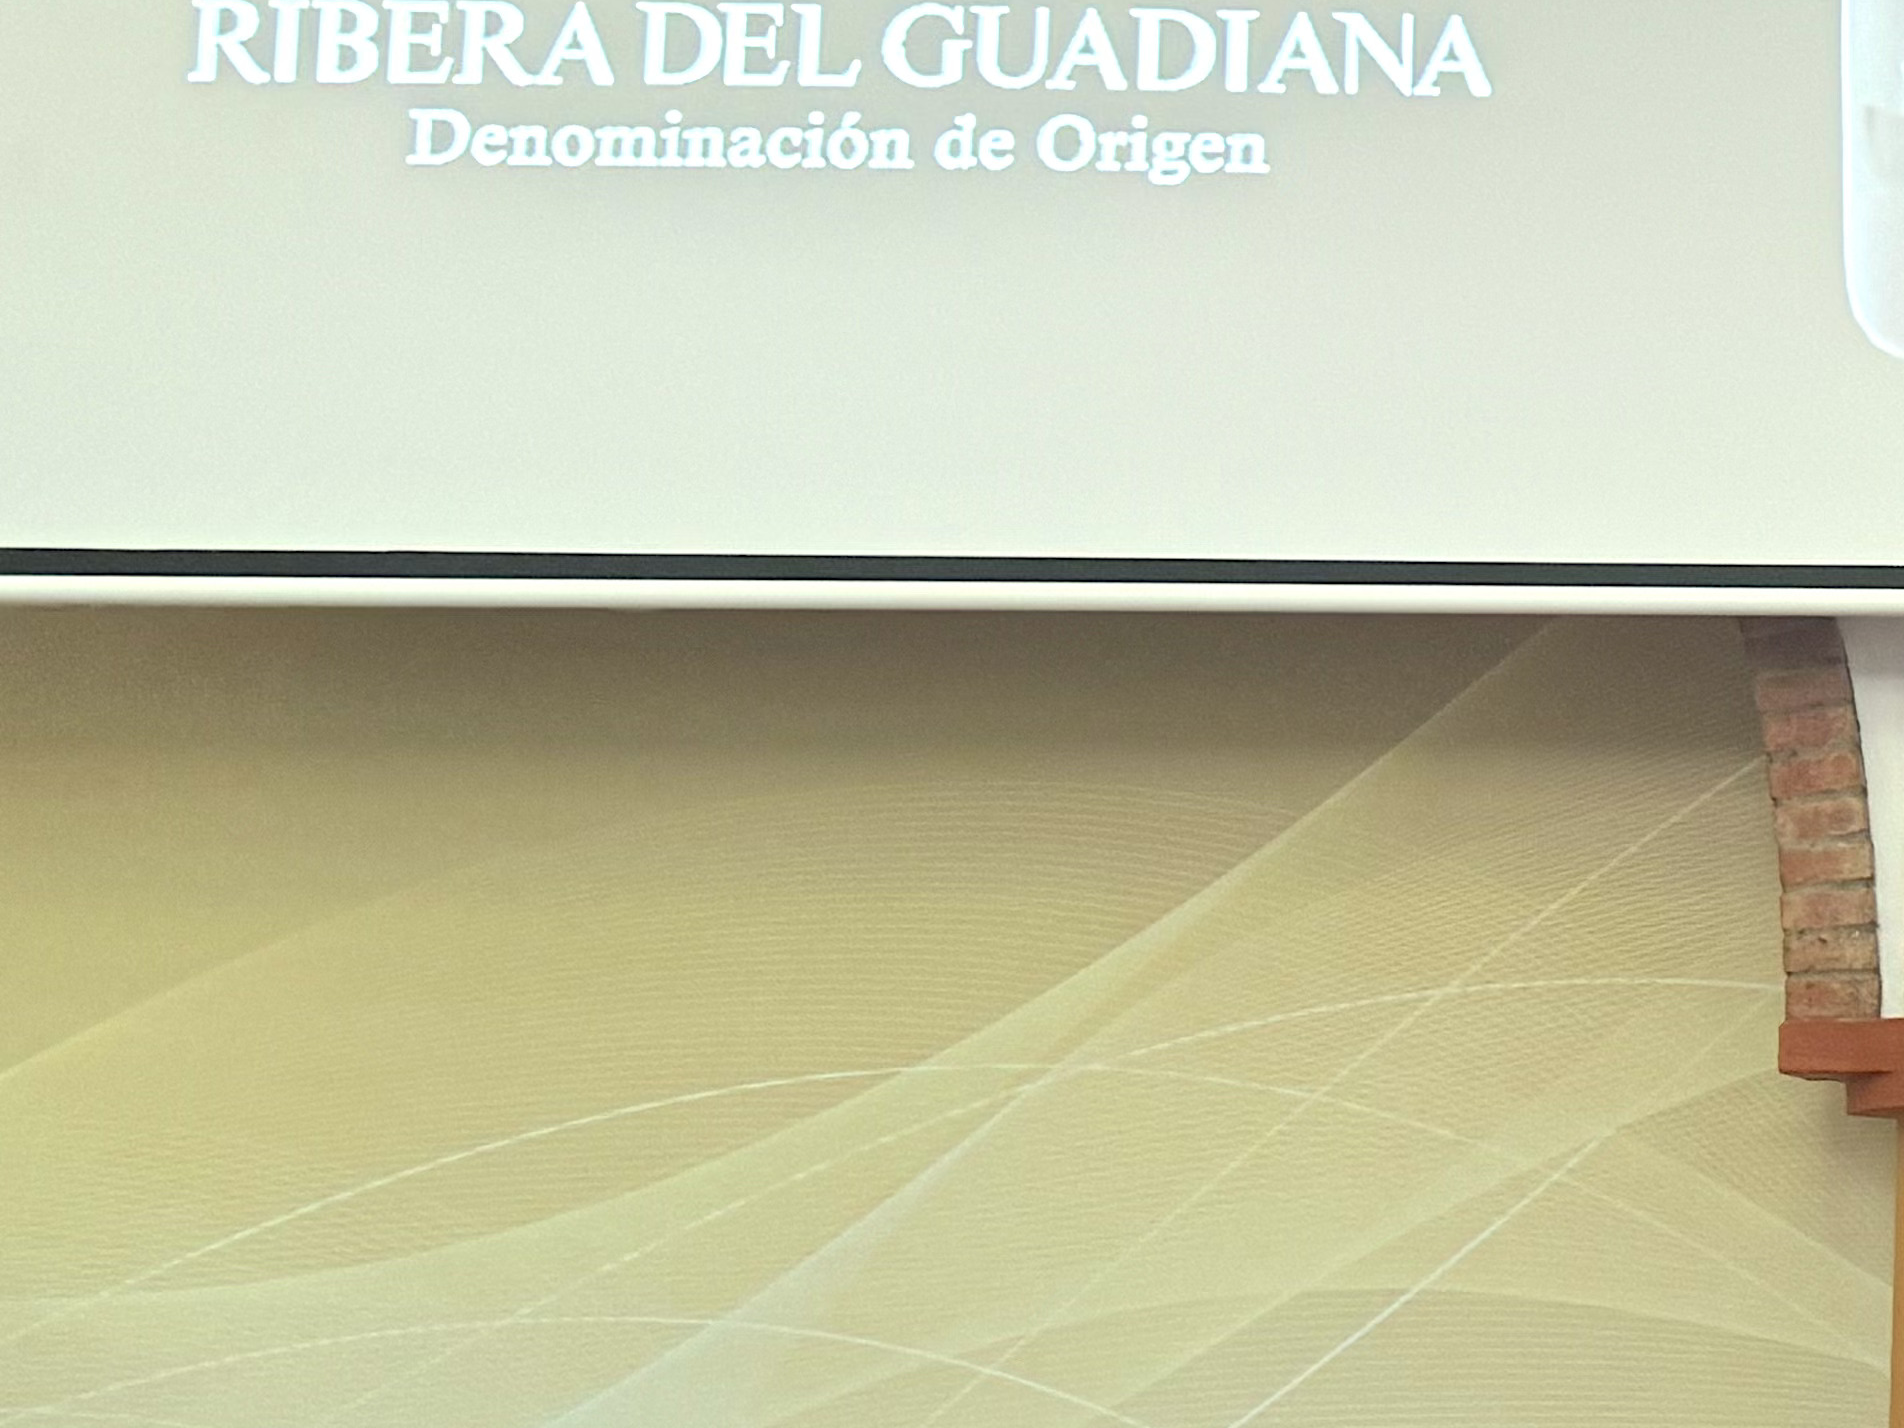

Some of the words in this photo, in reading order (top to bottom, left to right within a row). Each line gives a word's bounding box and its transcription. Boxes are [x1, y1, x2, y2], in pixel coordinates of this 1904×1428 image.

[635, 1, 862, 88] DEL
[882, 3, 1492, 99] GUADIANA
[406, 108, 915, 170] Denominación
[935, 113, 1015, 171] de
[1037, 114, 1271, 186] Origen
